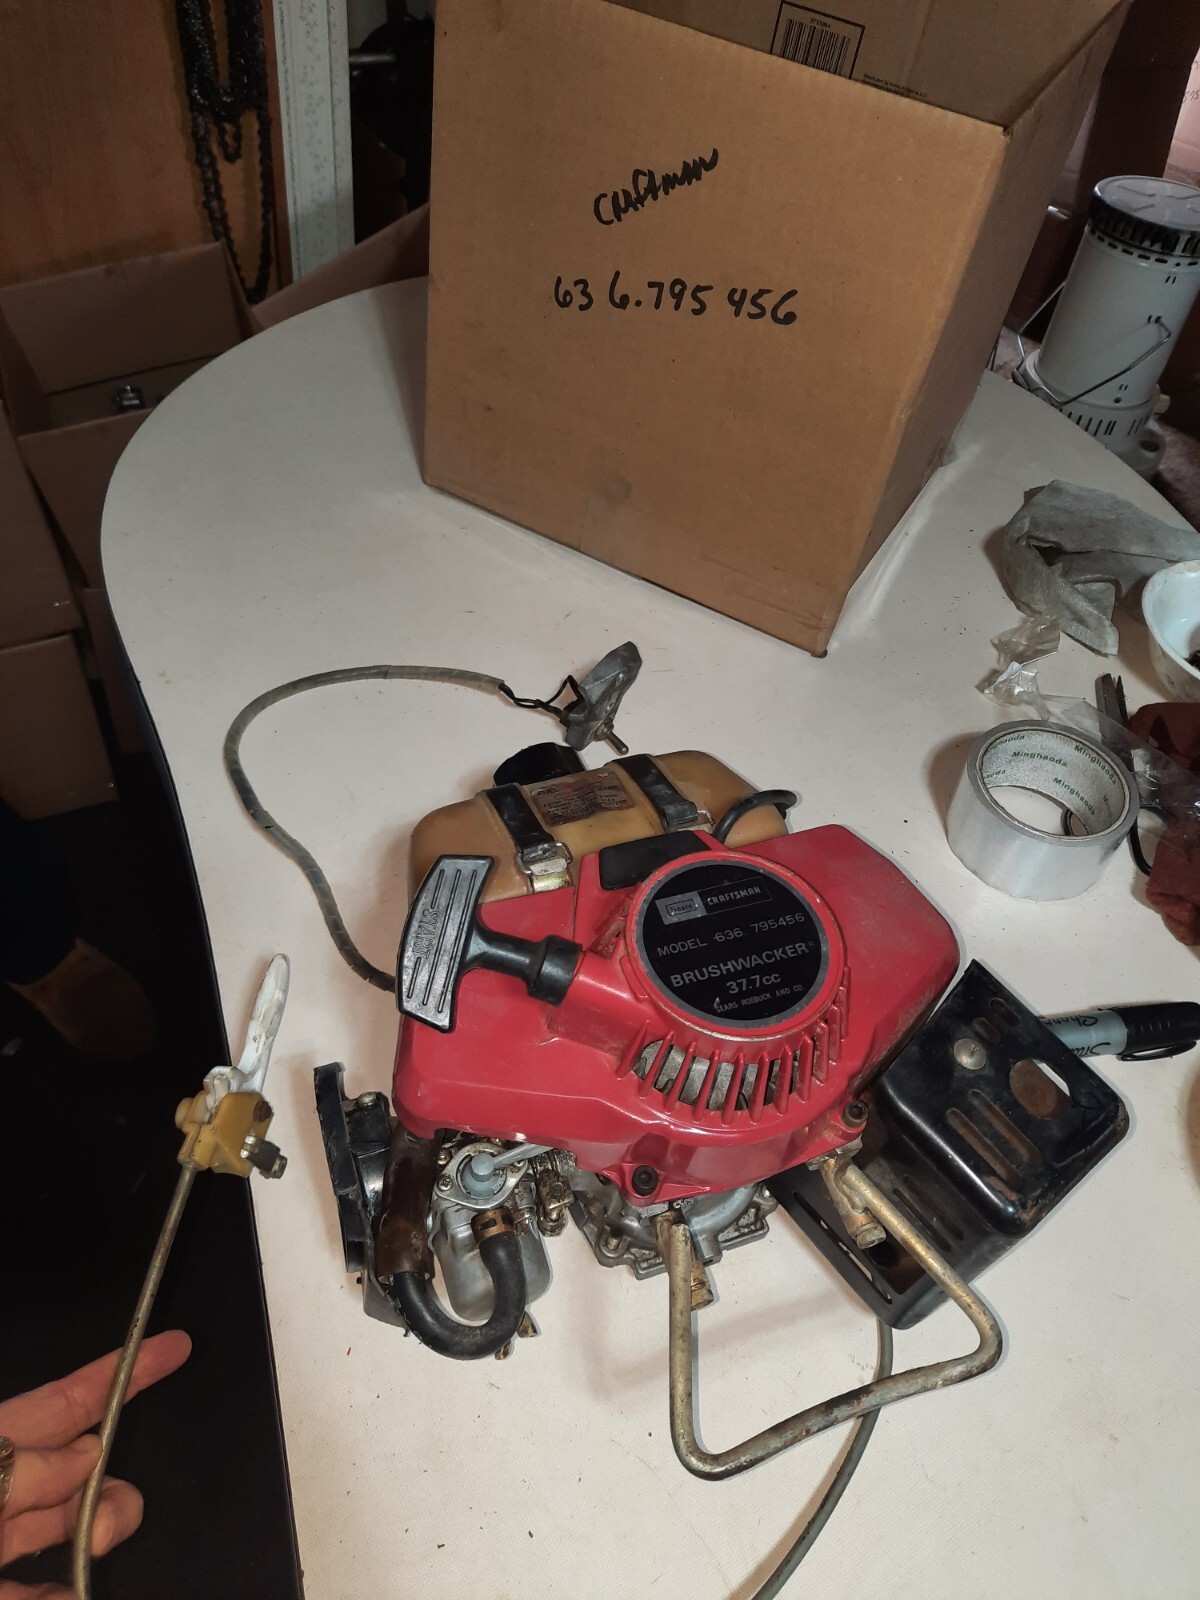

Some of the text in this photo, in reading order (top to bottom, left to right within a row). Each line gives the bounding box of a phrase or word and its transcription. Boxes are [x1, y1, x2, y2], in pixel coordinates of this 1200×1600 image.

[1011, 750, 1068, 768] Minghaoda
[1073, 743, 1118, 786] Minghaoda
[1053, 776, 1096, 816] Minghaoda
[670, 885, 761, 914] Sears CRAFTSMAN
[412, 908, 438, 959] START
[656, 936, 709, 957] MODEL
[750, 912, 806, 933] 795456
[715, 1001, 739, 1013] SEARS
[741, 992, 773, 1006] ROEBUCK
[775, 987, 791, 998] AND
[726, 972, 782, 995] 37.7cc
